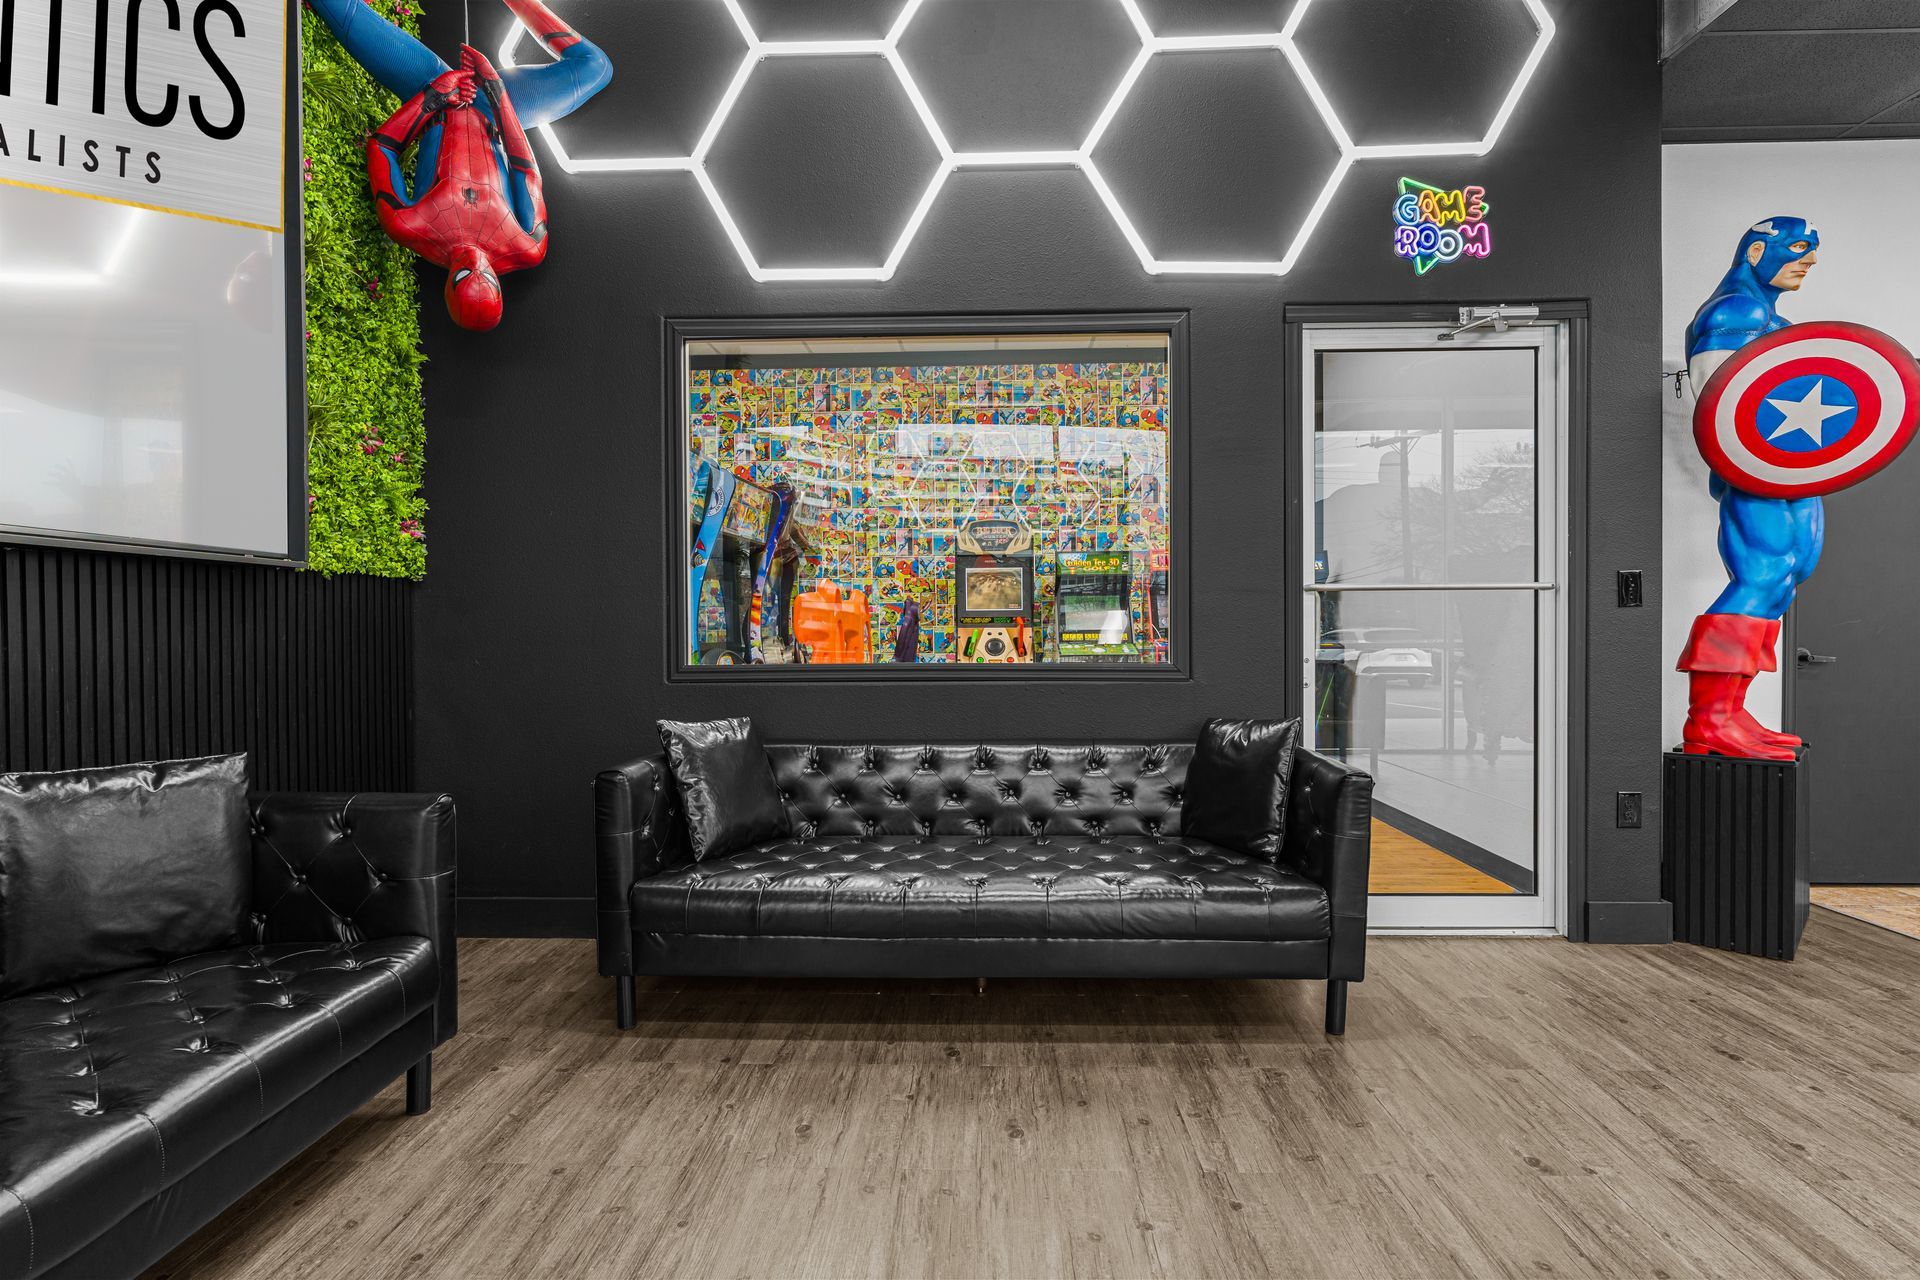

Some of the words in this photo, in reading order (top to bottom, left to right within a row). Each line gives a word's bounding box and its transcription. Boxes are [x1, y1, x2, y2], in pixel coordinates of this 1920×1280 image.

[1394, 186, 1486, 225] GAME
[1395, 222, 1490, 261] ROOM
[1064, 559, 1091, 568] Golden
[1093, 558, 1106, 567] Tee
[1108, 557, 1120, 567] 3D
